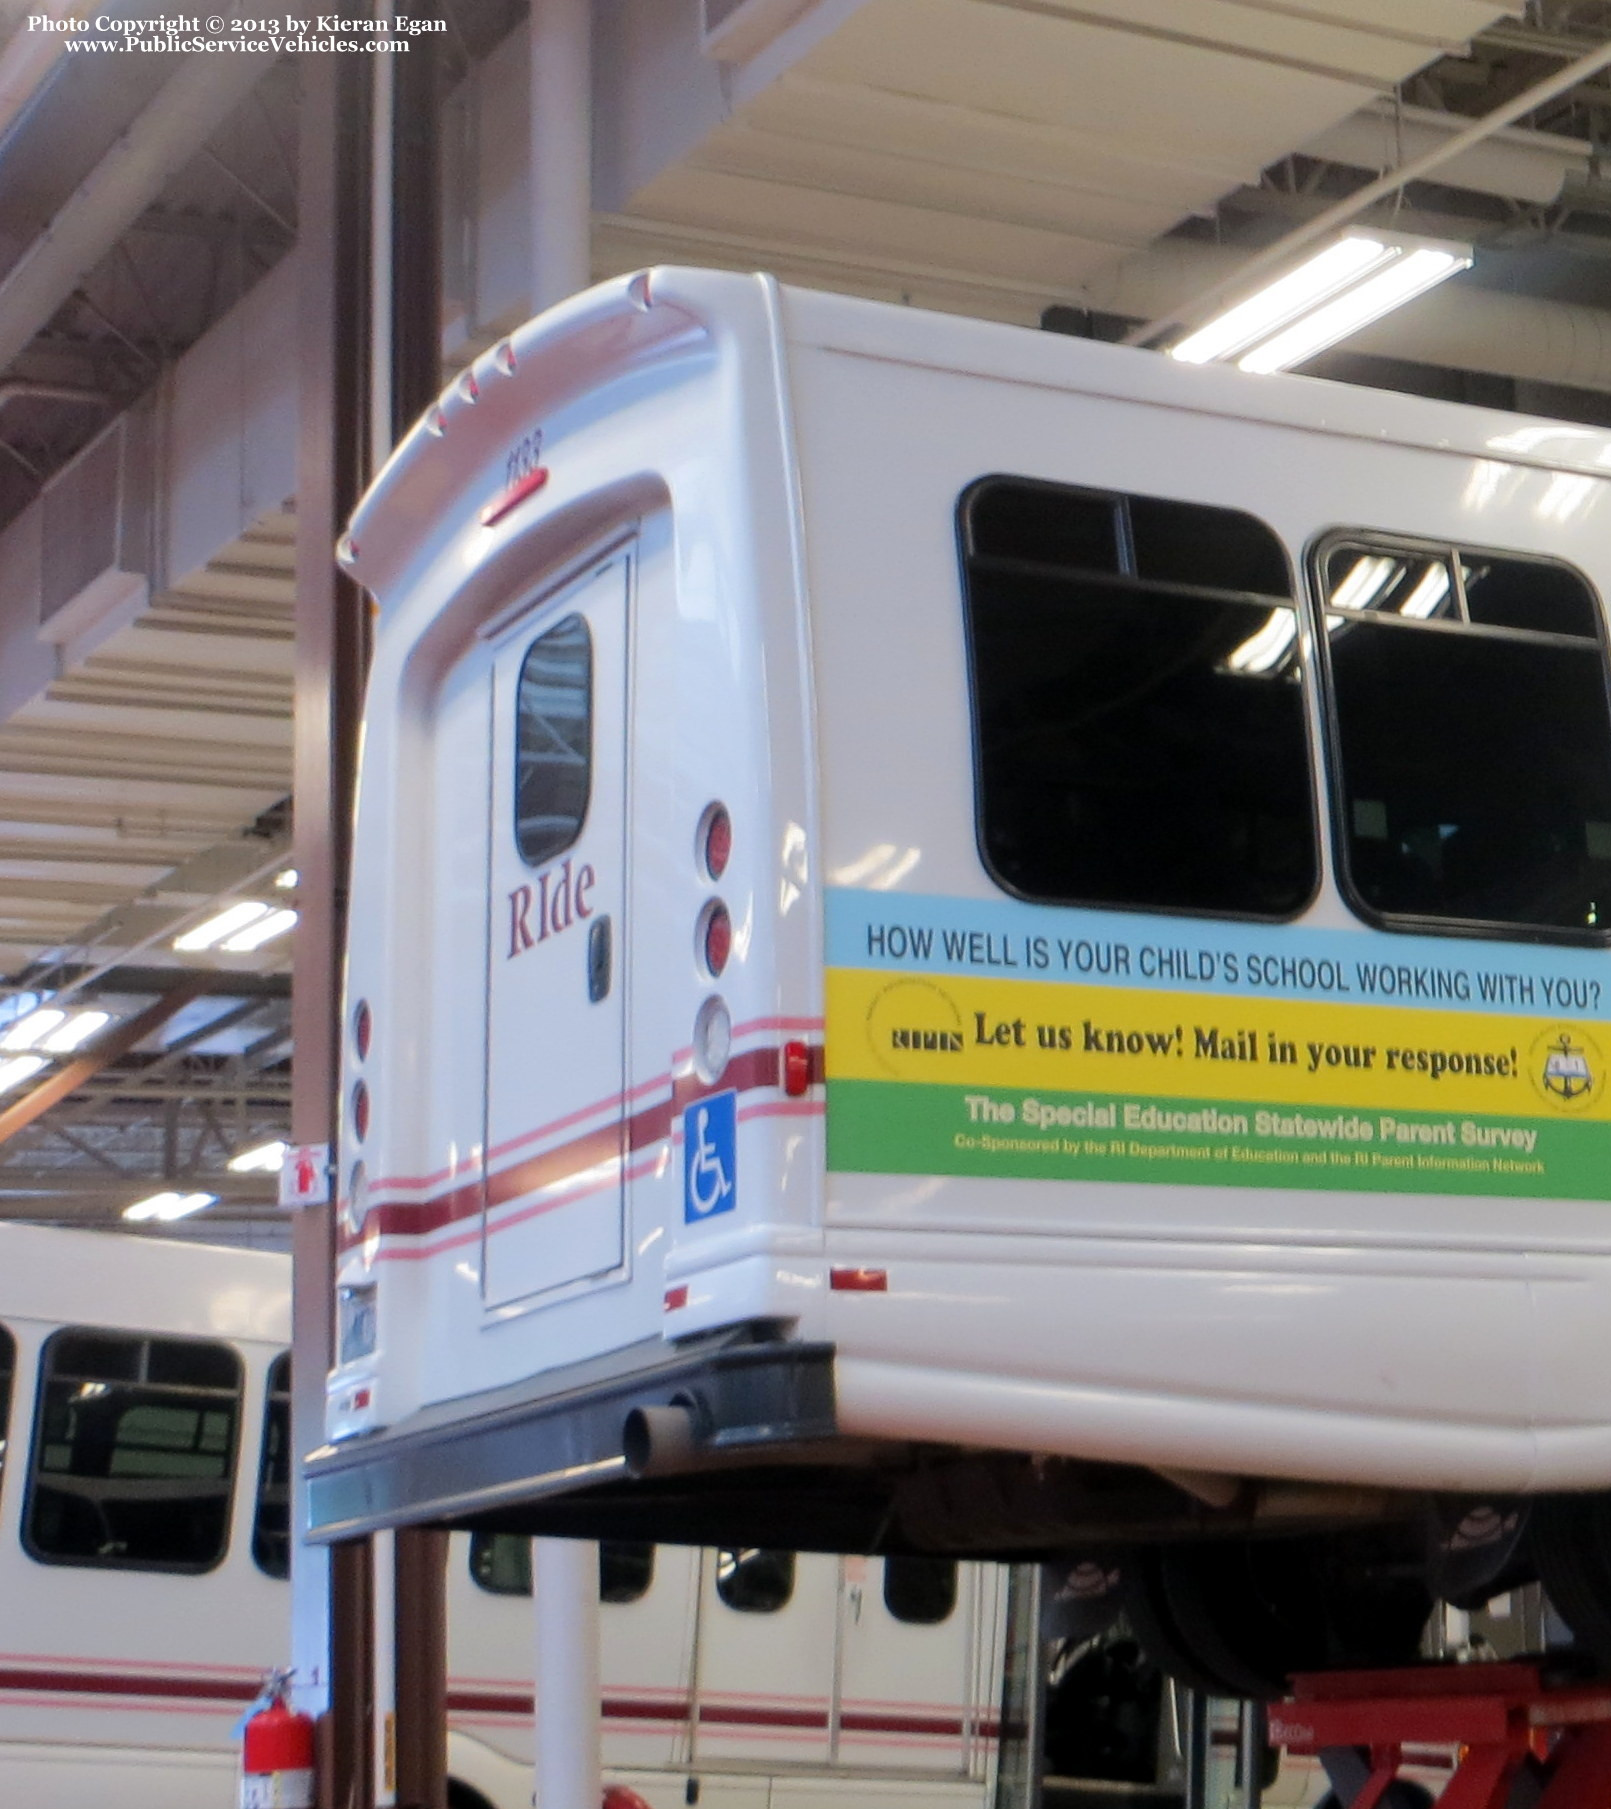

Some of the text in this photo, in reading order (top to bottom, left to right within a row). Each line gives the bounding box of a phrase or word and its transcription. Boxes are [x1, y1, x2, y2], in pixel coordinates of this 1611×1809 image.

[507, 858, 596, 960] RIde
[867, 924, 1601, 1010] HOW WELL IS YOUR CHILD'S SCHOOL WORKING WITH YOU?
[974, 1011, 1518, 1080] Let us know! Mail in your response!
[954, 1133, 1060, 1152] Co-Sponsored
[1063, 1139, 1080, 1155] by
[1084, 1141, 1105, 1155] the
[1110, 1141, 1125, 1155] RI
[1130, 1142, 1211, 1161] Department
[1231, 1146, 1299, 1164] Education
[1302, 1150, 1328, 1165] and
[1331, 1151, 1351, 1166] the
[1355, 1152, 1369, 1167] RI
[1372, 1153, 1414, 1169] Parent
[1418, 1155, 1490, 1172] Information
[1493, 1159, 1546, 1175] Network
[965, 1094, 1538, 1153] The Special Education Statewide Parent Survey
